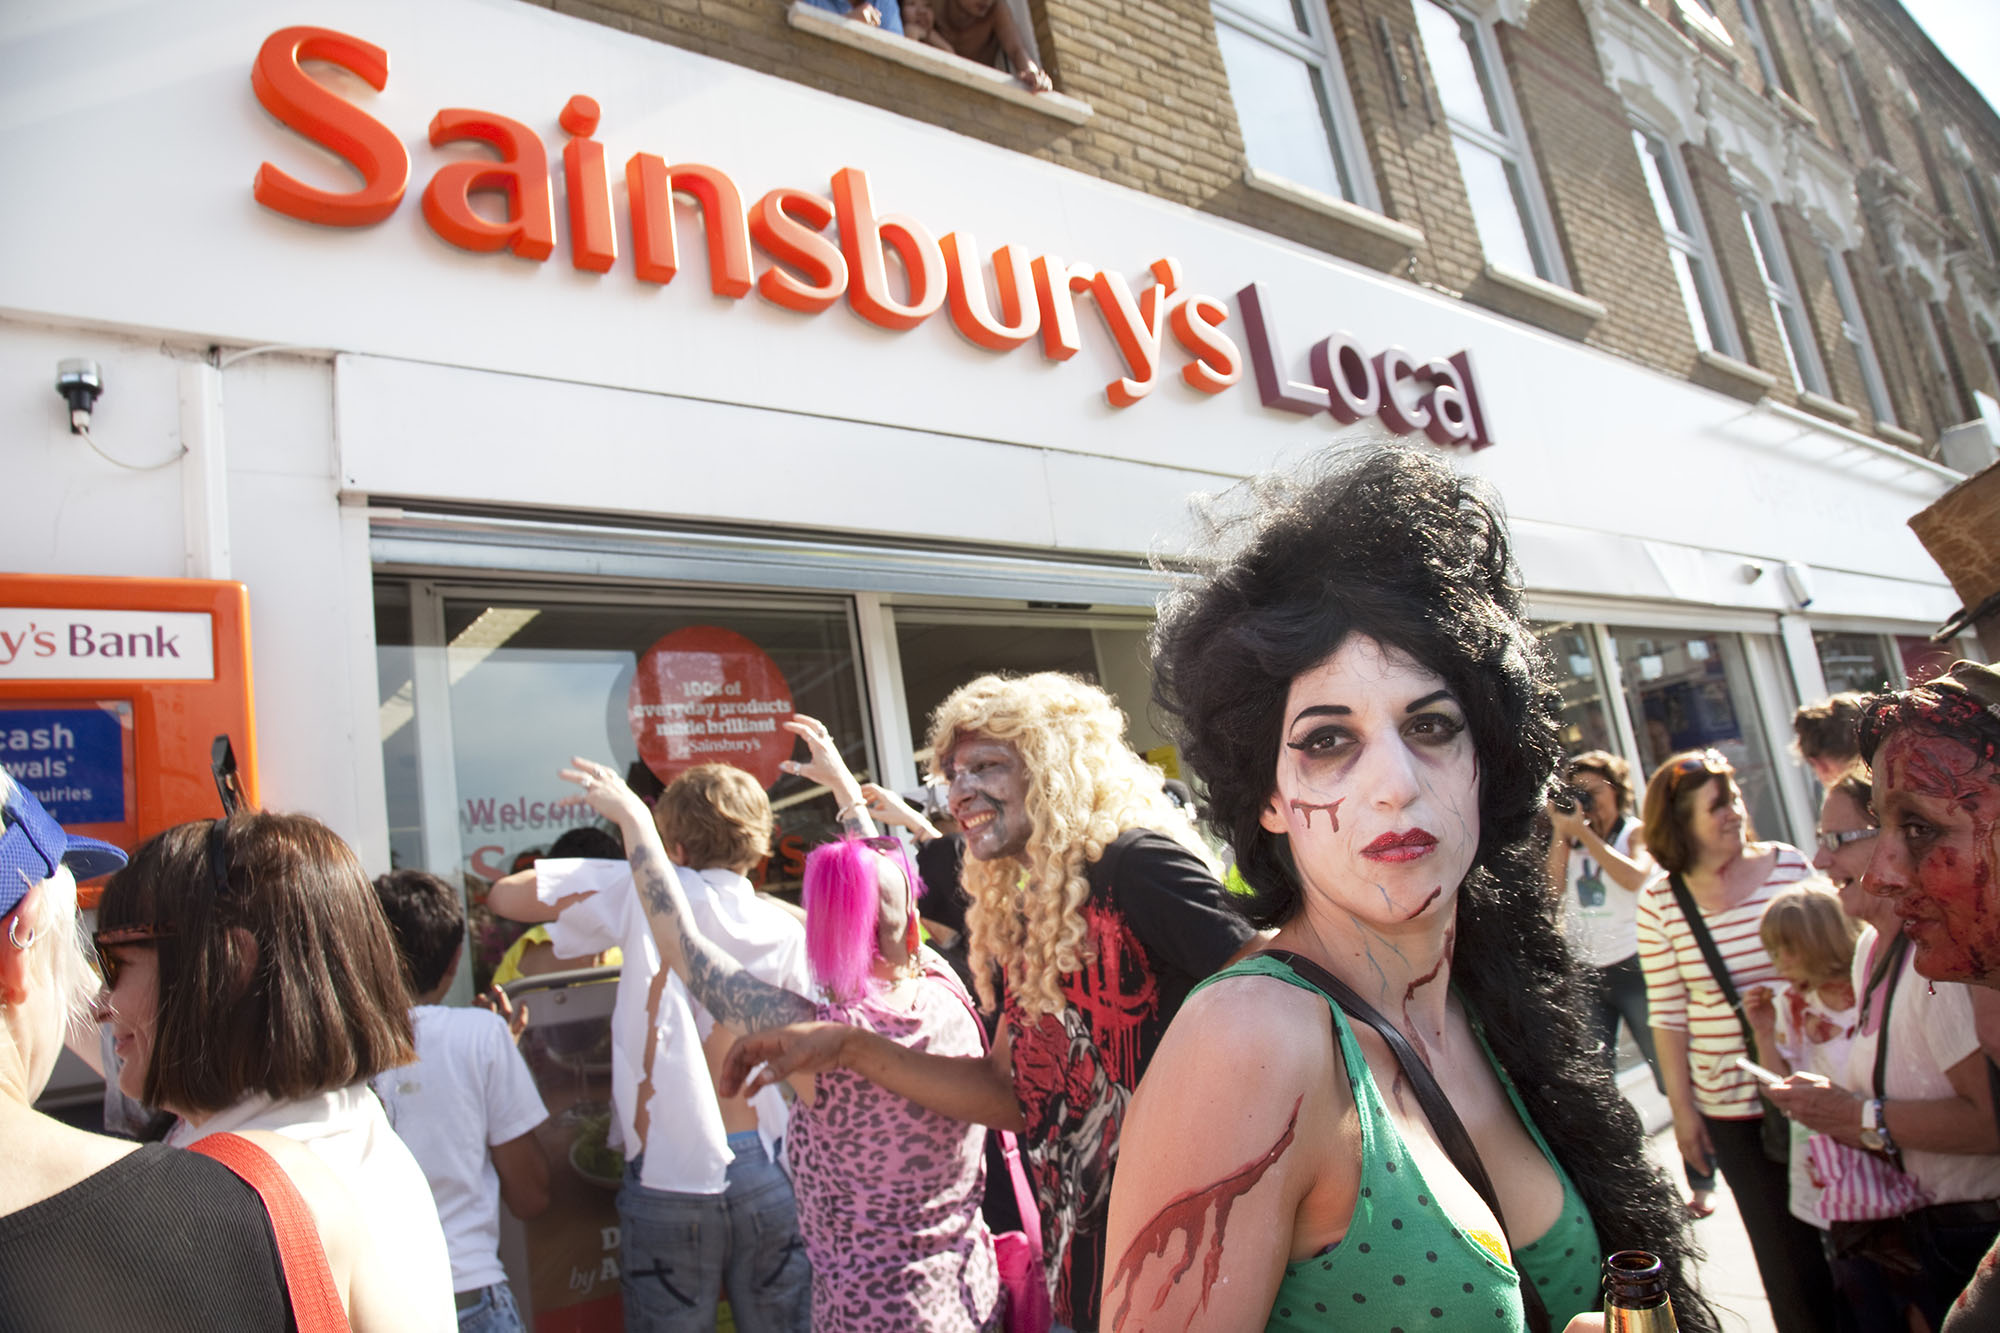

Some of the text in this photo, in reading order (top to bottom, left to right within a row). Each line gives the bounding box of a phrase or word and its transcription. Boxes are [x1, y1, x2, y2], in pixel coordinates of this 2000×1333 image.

[251, 26, 1495, 451] Sainsbury's Local
[69, 624, 180, 658] Bank
[725, 680, 742, 697] of
[633, 699, 792, 719] everyday products
[706, 716, 777, 735] brilliant
[467, 796, 597, 826] Welcom
